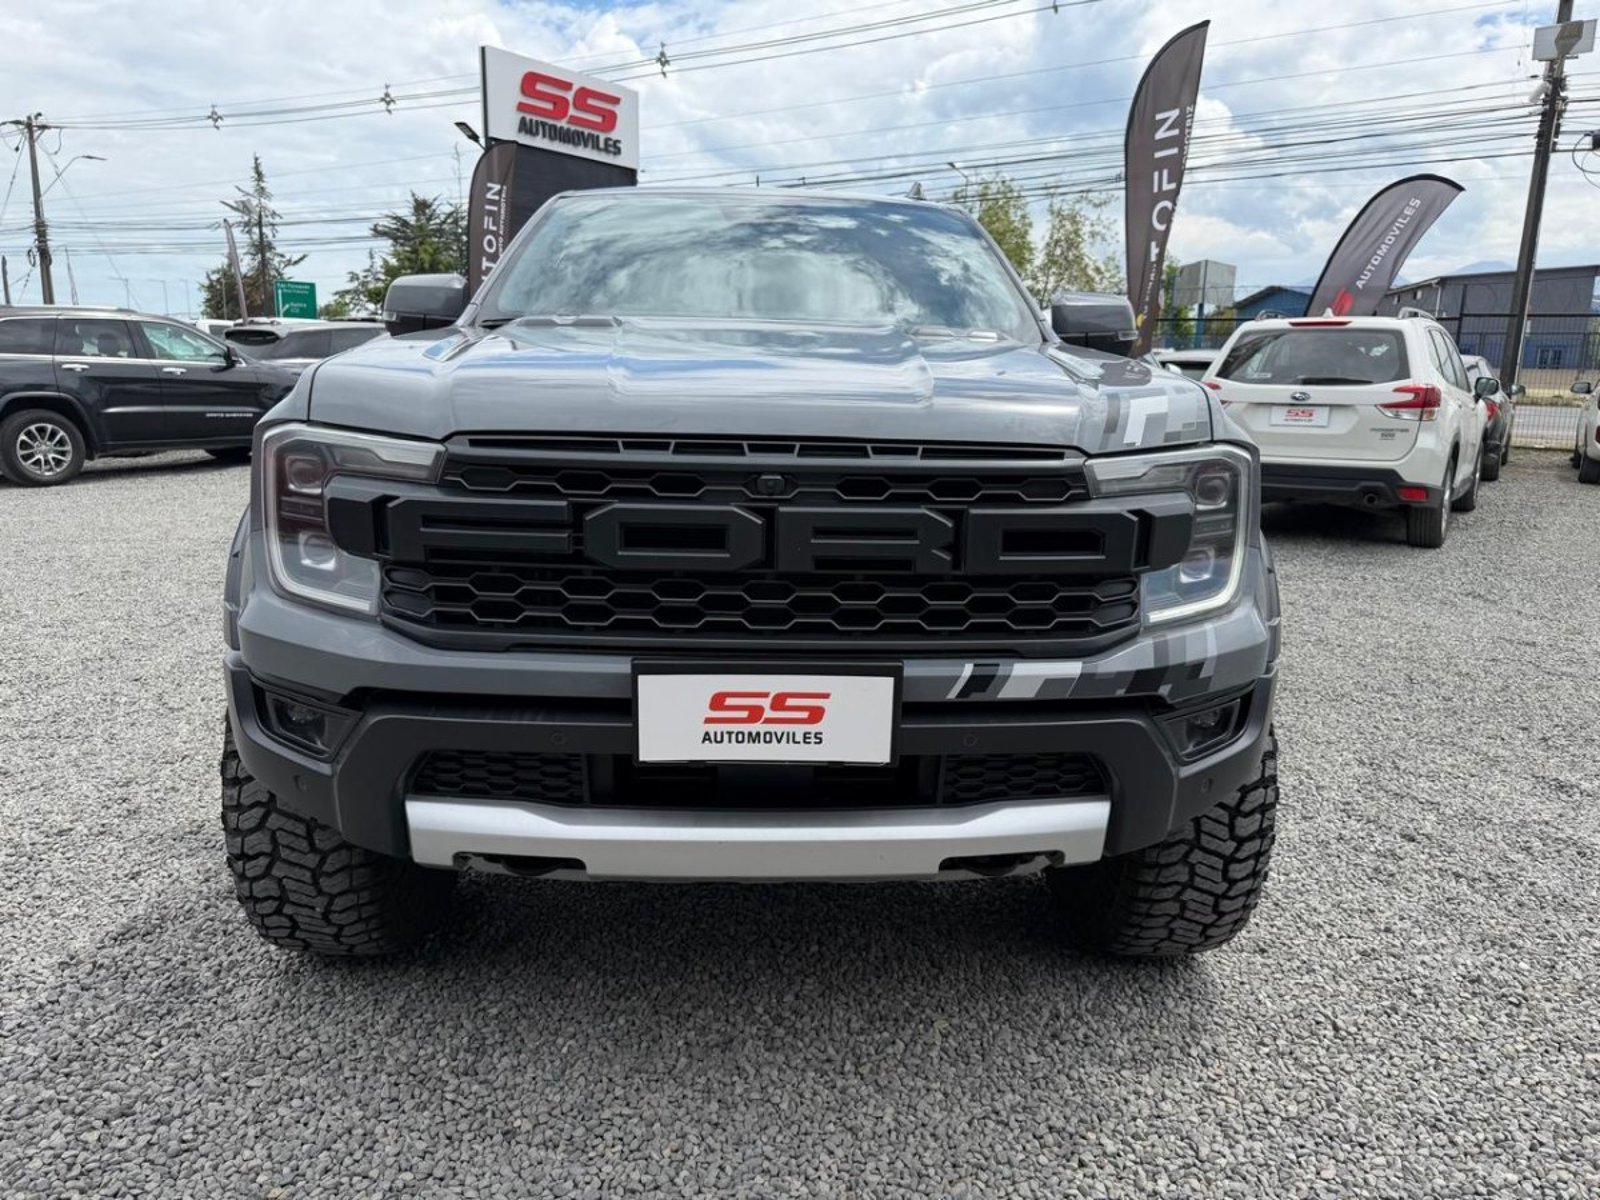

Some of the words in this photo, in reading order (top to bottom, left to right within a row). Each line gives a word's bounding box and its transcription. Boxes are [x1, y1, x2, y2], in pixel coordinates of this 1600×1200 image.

[516, 71, 621, 134] SS
[518, 116, 622, 156] AUTOMOVILES
[481, 182, 501, 281] TOFIN
[1355, 197, 1422, 290] AUTOMOVILES
[386, 496, 1139, 575] FORD
[701, 730, 824, 745] AUTOMOVILES
[703, 691, 832, 725] SS
